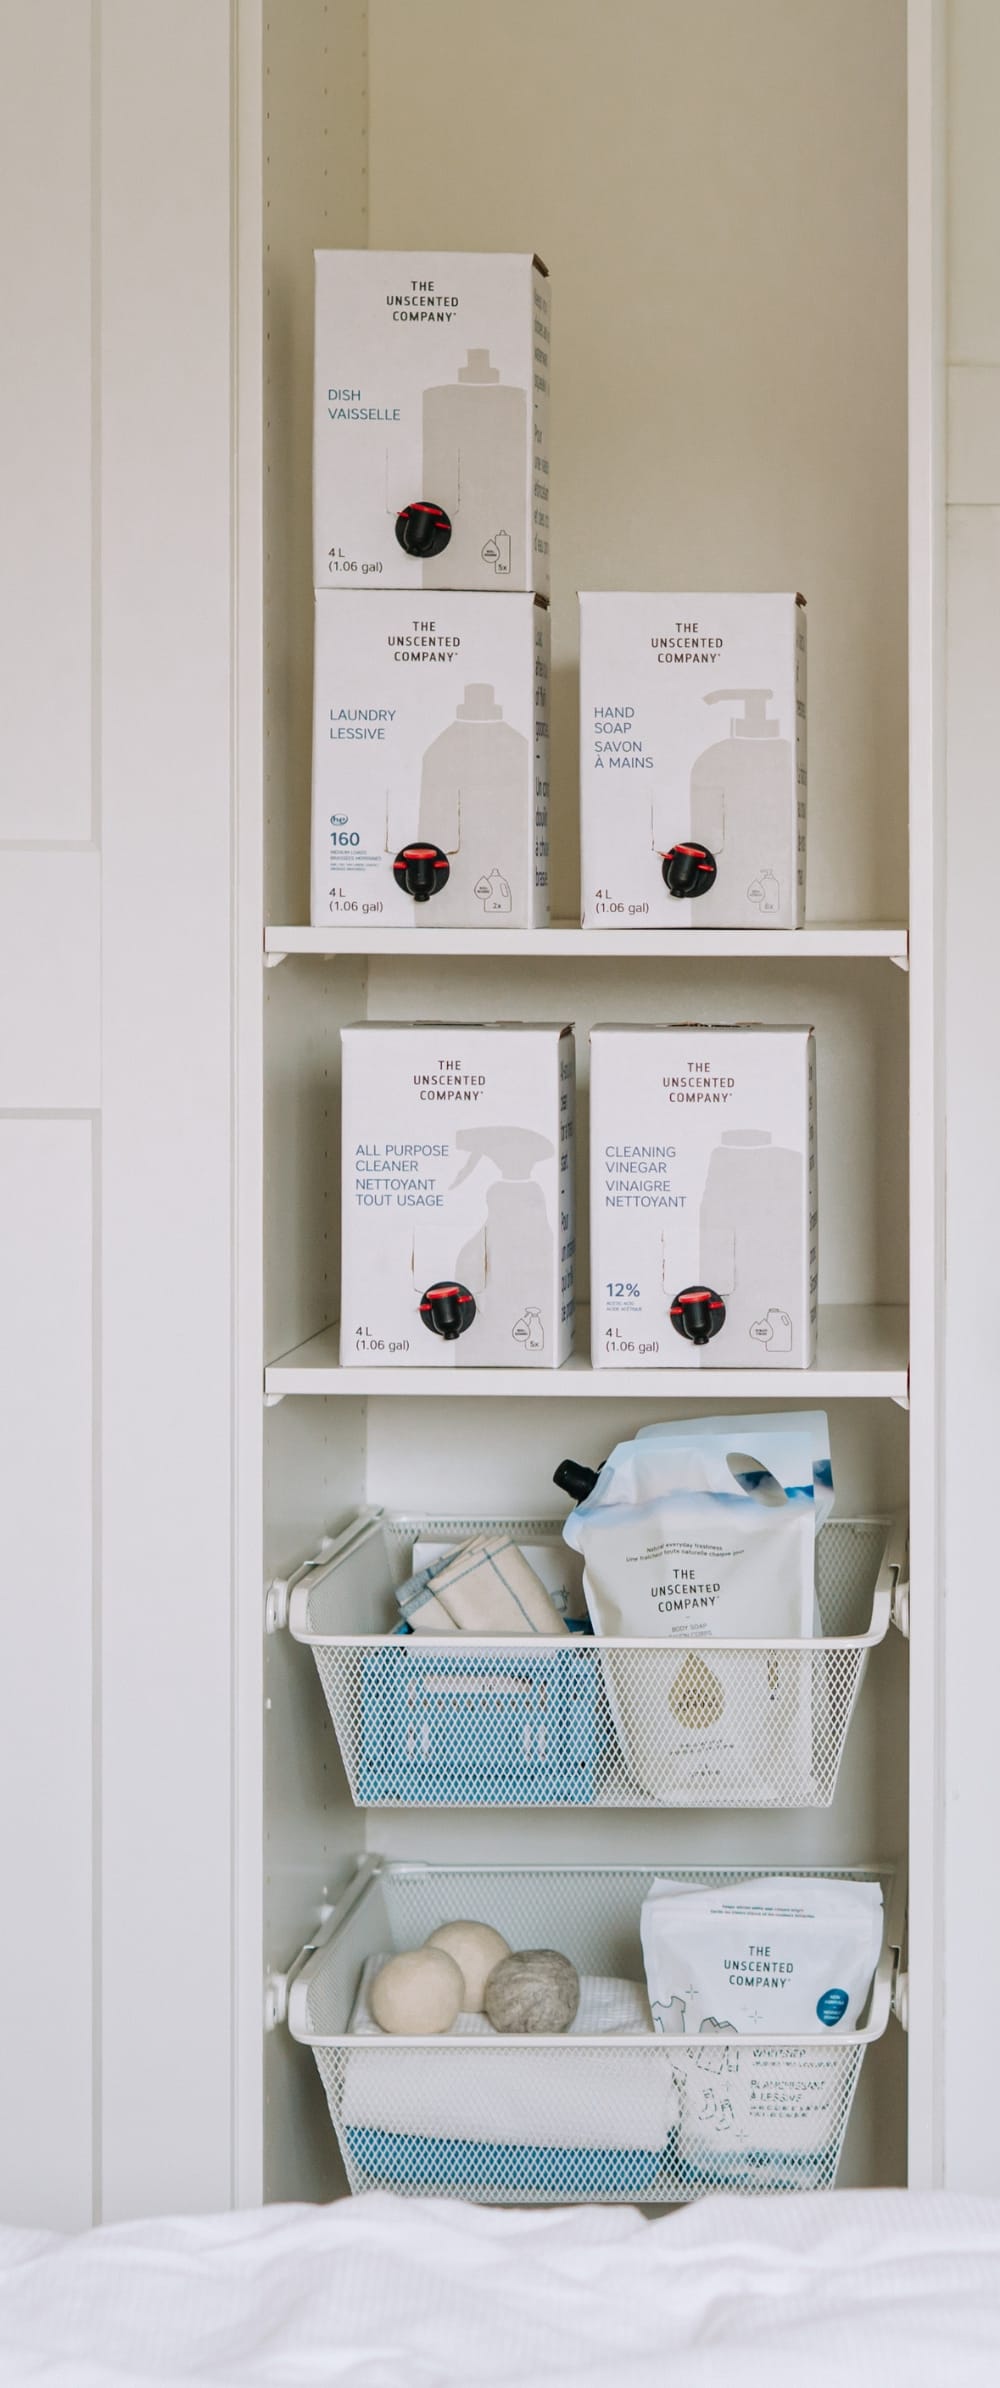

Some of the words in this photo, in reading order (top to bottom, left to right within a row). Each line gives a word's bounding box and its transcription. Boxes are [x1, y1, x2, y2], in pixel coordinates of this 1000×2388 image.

[410, 280, 434, 292] THE
[386, 295, 459, 308] UNSCENTED
[392, 310, 455, 323] COMPANY
[328, 388, 361, 401] DISH
[327, 407, 401, 421] VAISSELLE
[327, 547, 336, 558] 4
[337, 547, 345, 558] L
[327, 560, 357, 575] (1.06
[360, 560, 383, 575] gal)
[412, 620, 436, 632] THE
[675, 622, 699, 633] THE
[387, 636, 461, 648] UNSCENTED
[650, 637, 723, 649] UNSCENTED
[394, 651, 456, 662] COMPANY
[657, 652, 718, 664] COMPANY
[330, 708, 397, 722] LAUNDRY
[594, 706, 635, 719] HAND
[329, 727, 385, 740] LESSIVE
[594, 721, 632, 734] SOAP
[594, 740, 643, 753] SAVON
[594, 753, 605, 769] À
[609, 756, 654, 769] MAINS
[330, 831, 360, 847] 160
[328, 887, 337, 898] 4
[338, 887, 346, 898] L
[594, 889, 603, 900] 4
[604, 889, 612, 900] L
[328, 900, 358, 914] (1.06
[361, 900, 384, 914] gal)
[594, 902, 624, 916] (1.06
[627, 902, 650, 916] gal)
[438, 1060, 461, 1071] THE
[687, 1062, 711, 1073] THE
[413, 1075, 486, 1086] UNSCENTED
[662, 1077, 735, 1088] UNSCENTED
[419, 1090, 481, 1101] COMPANY
[669, 1092, 730, 1103] COMPANY
[355, 1144, 381, 1157] ALL
[385, 1144, 449, 1157] PURPOSE
[605, 1145, 677, 1158] CLEANING
[355, 1159, 419, 1172] CLEANER
[605, 1161, 667, 1174] VINEGAR
[355, 1178, 436, 1191] NETTOYANT
[605, 1180, 671, 1192] VINAIGRE
[355, 1193, 393, 1207] TOUT
[396, 1193, 444, 1207] USAGE
[605, 1195, 687, 1208] NETTOYANT
[606, 1282, 641, 1298] 12%
[355, 1326, 364, 1337] 4
[365, 1326, 373, 1337] L
[605, 1327, 614, 1338] 4
[615, 1327, 623, 1338] L
[355, 1339, 385, 1353] (1.06
[388, 1339, 411, 1353] gal)
[605, 1340, 635, 1355] (1.06
[638, 1340, 661, 1355] gal)
[672, 1568, 696, 1580] THE
[650, 1583, 721, 1598] UNSCENTED
[657, 1596, 717, 1613] COMPANY
[748, 1945, 772, 1958] THE
[723, 1959, 795, 1974] UNSCENTED
[728, 1974, 788, 1989] COMPANY
